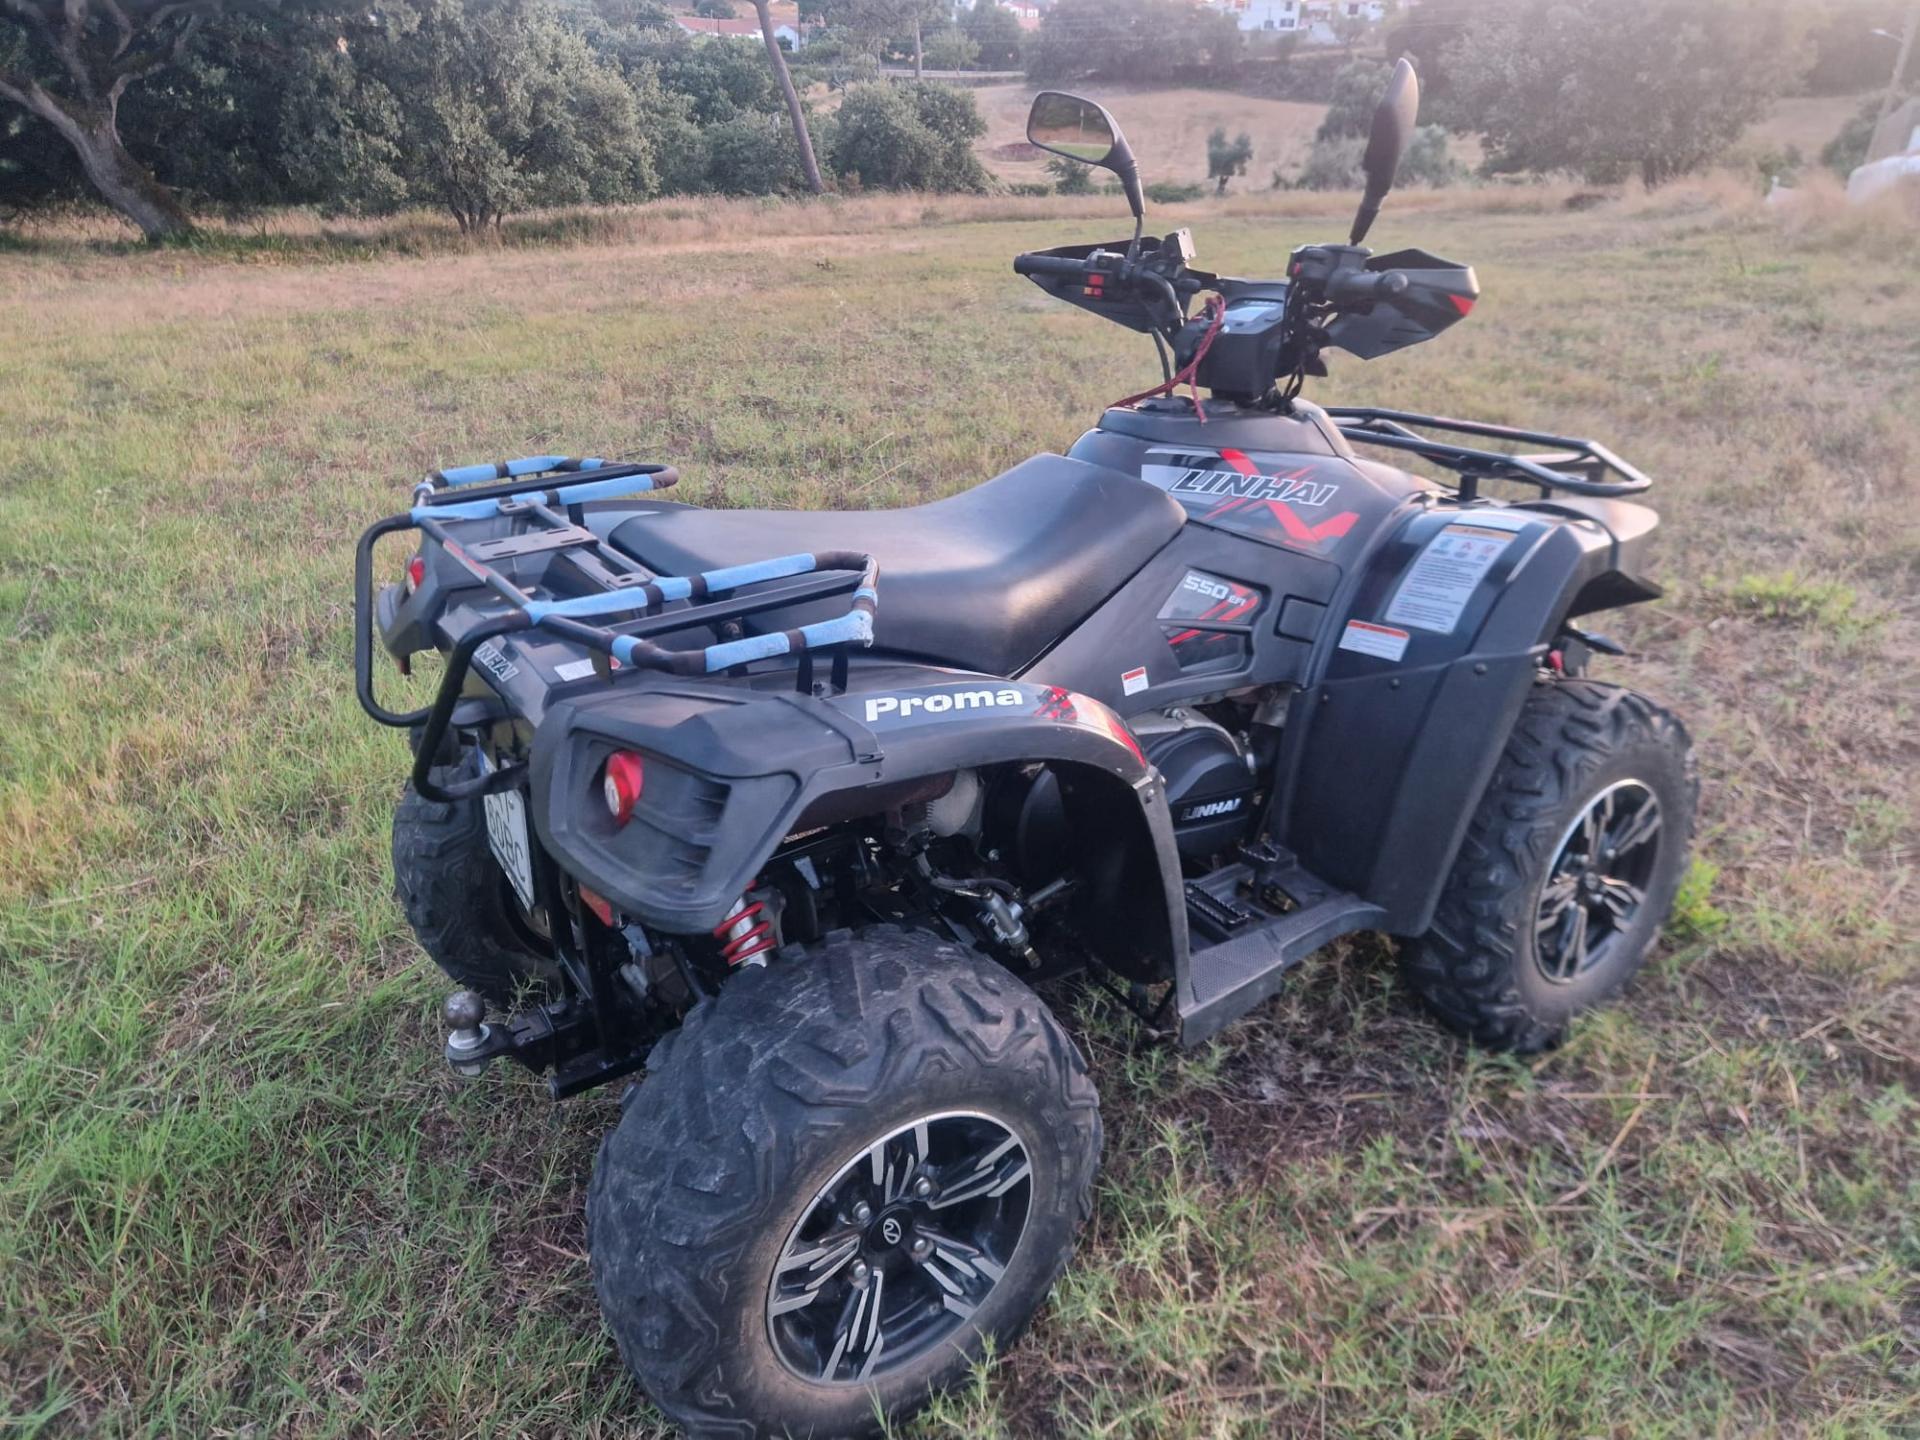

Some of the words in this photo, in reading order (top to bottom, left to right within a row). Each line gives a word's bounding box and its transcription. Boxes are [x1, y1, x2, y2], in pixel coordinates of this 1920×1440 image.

[1168, 469, 1339, 506] LINHAI
[1183, 575, 1229, 600] 550
[865, 689, 1023, 722] Proma
[1181, 798, 1241, 820] LINHAI
